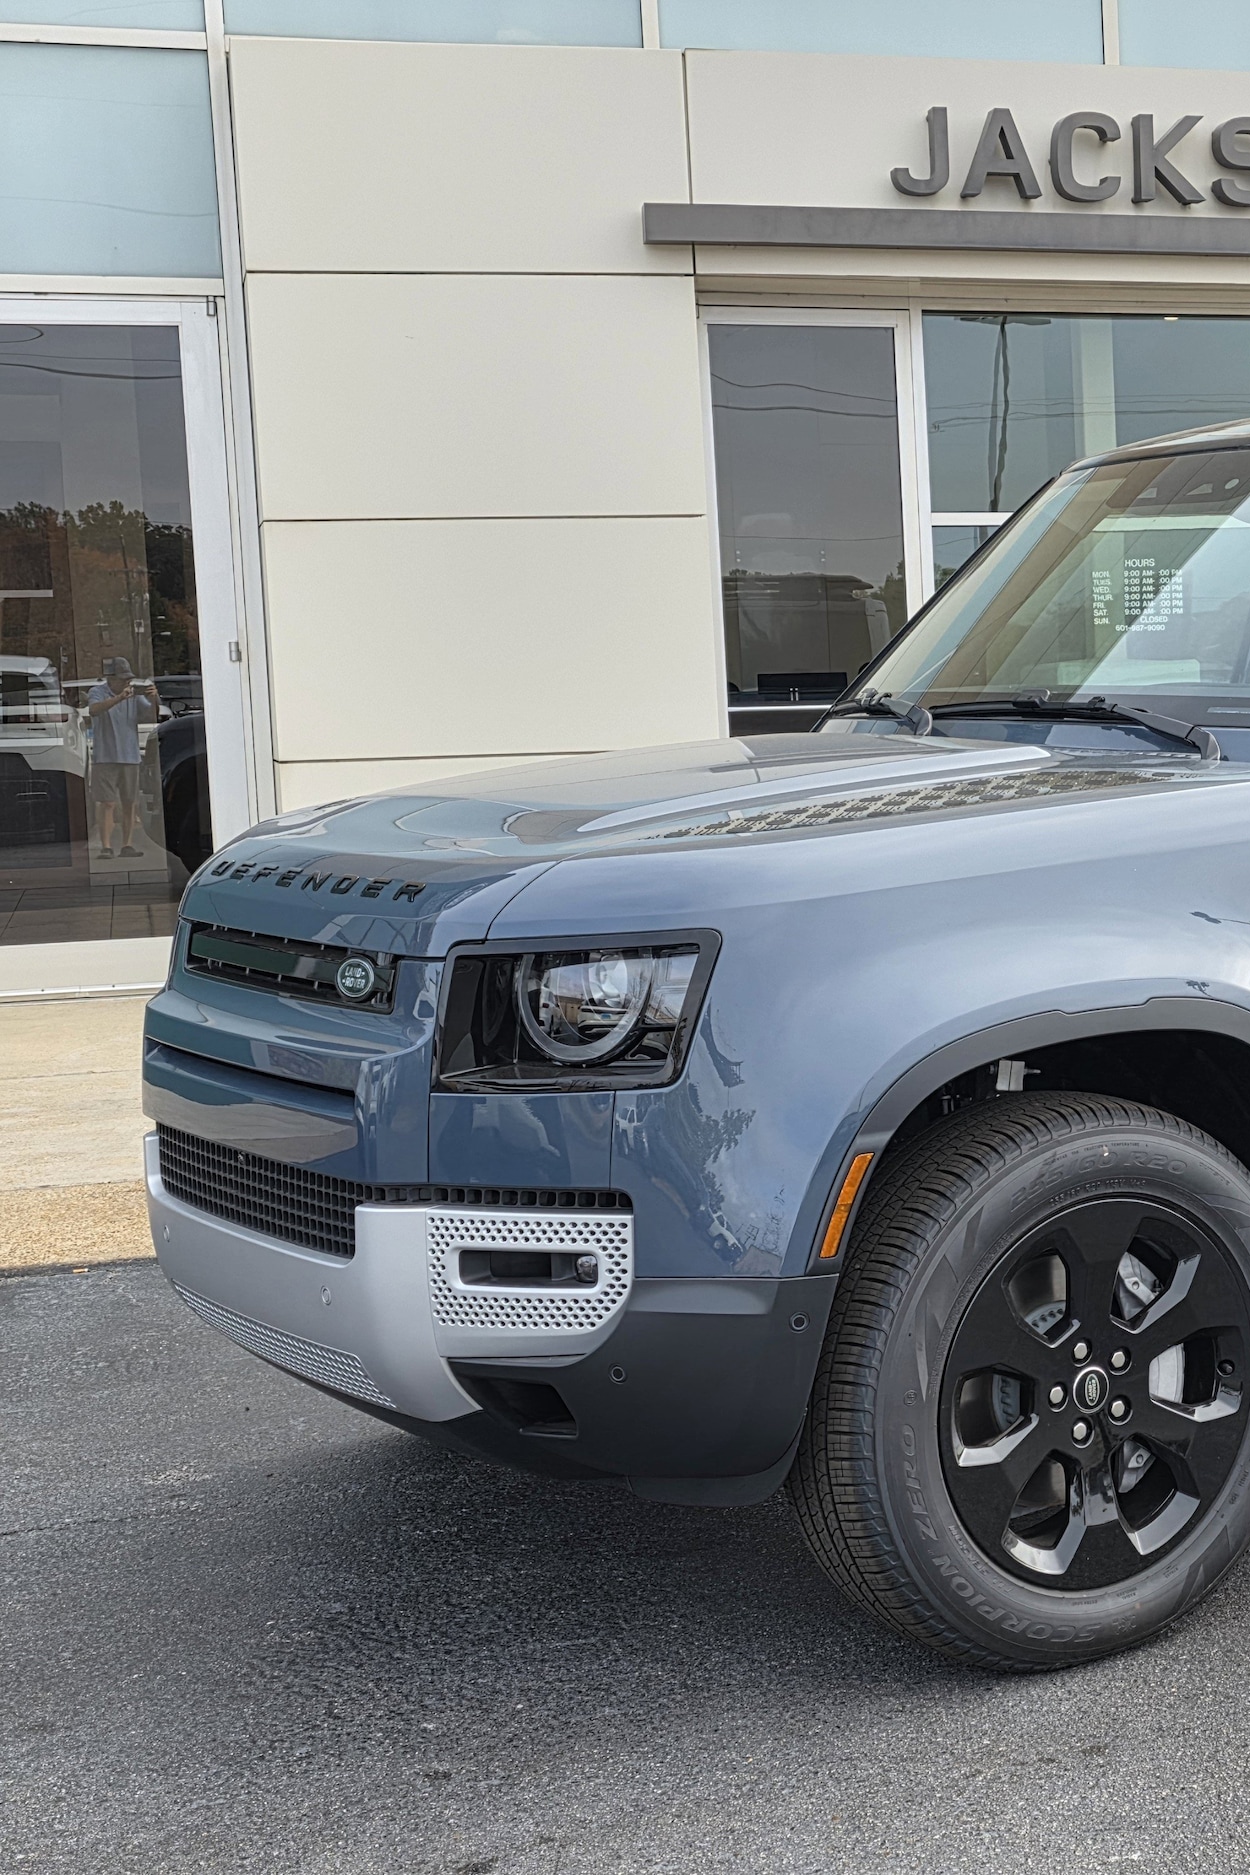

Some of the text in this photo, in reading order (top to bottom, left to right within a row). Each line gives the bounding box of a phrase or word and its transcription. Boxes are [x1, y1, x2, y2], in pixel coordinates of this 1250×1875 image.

[1124, 559, 1155, 567] HOURS
[210, 859, 427, 903] DEFENDER
[1124, 1151, 1188, 1174] R20
[901, 1424, 1102, 1643] SCORPION ZERO
